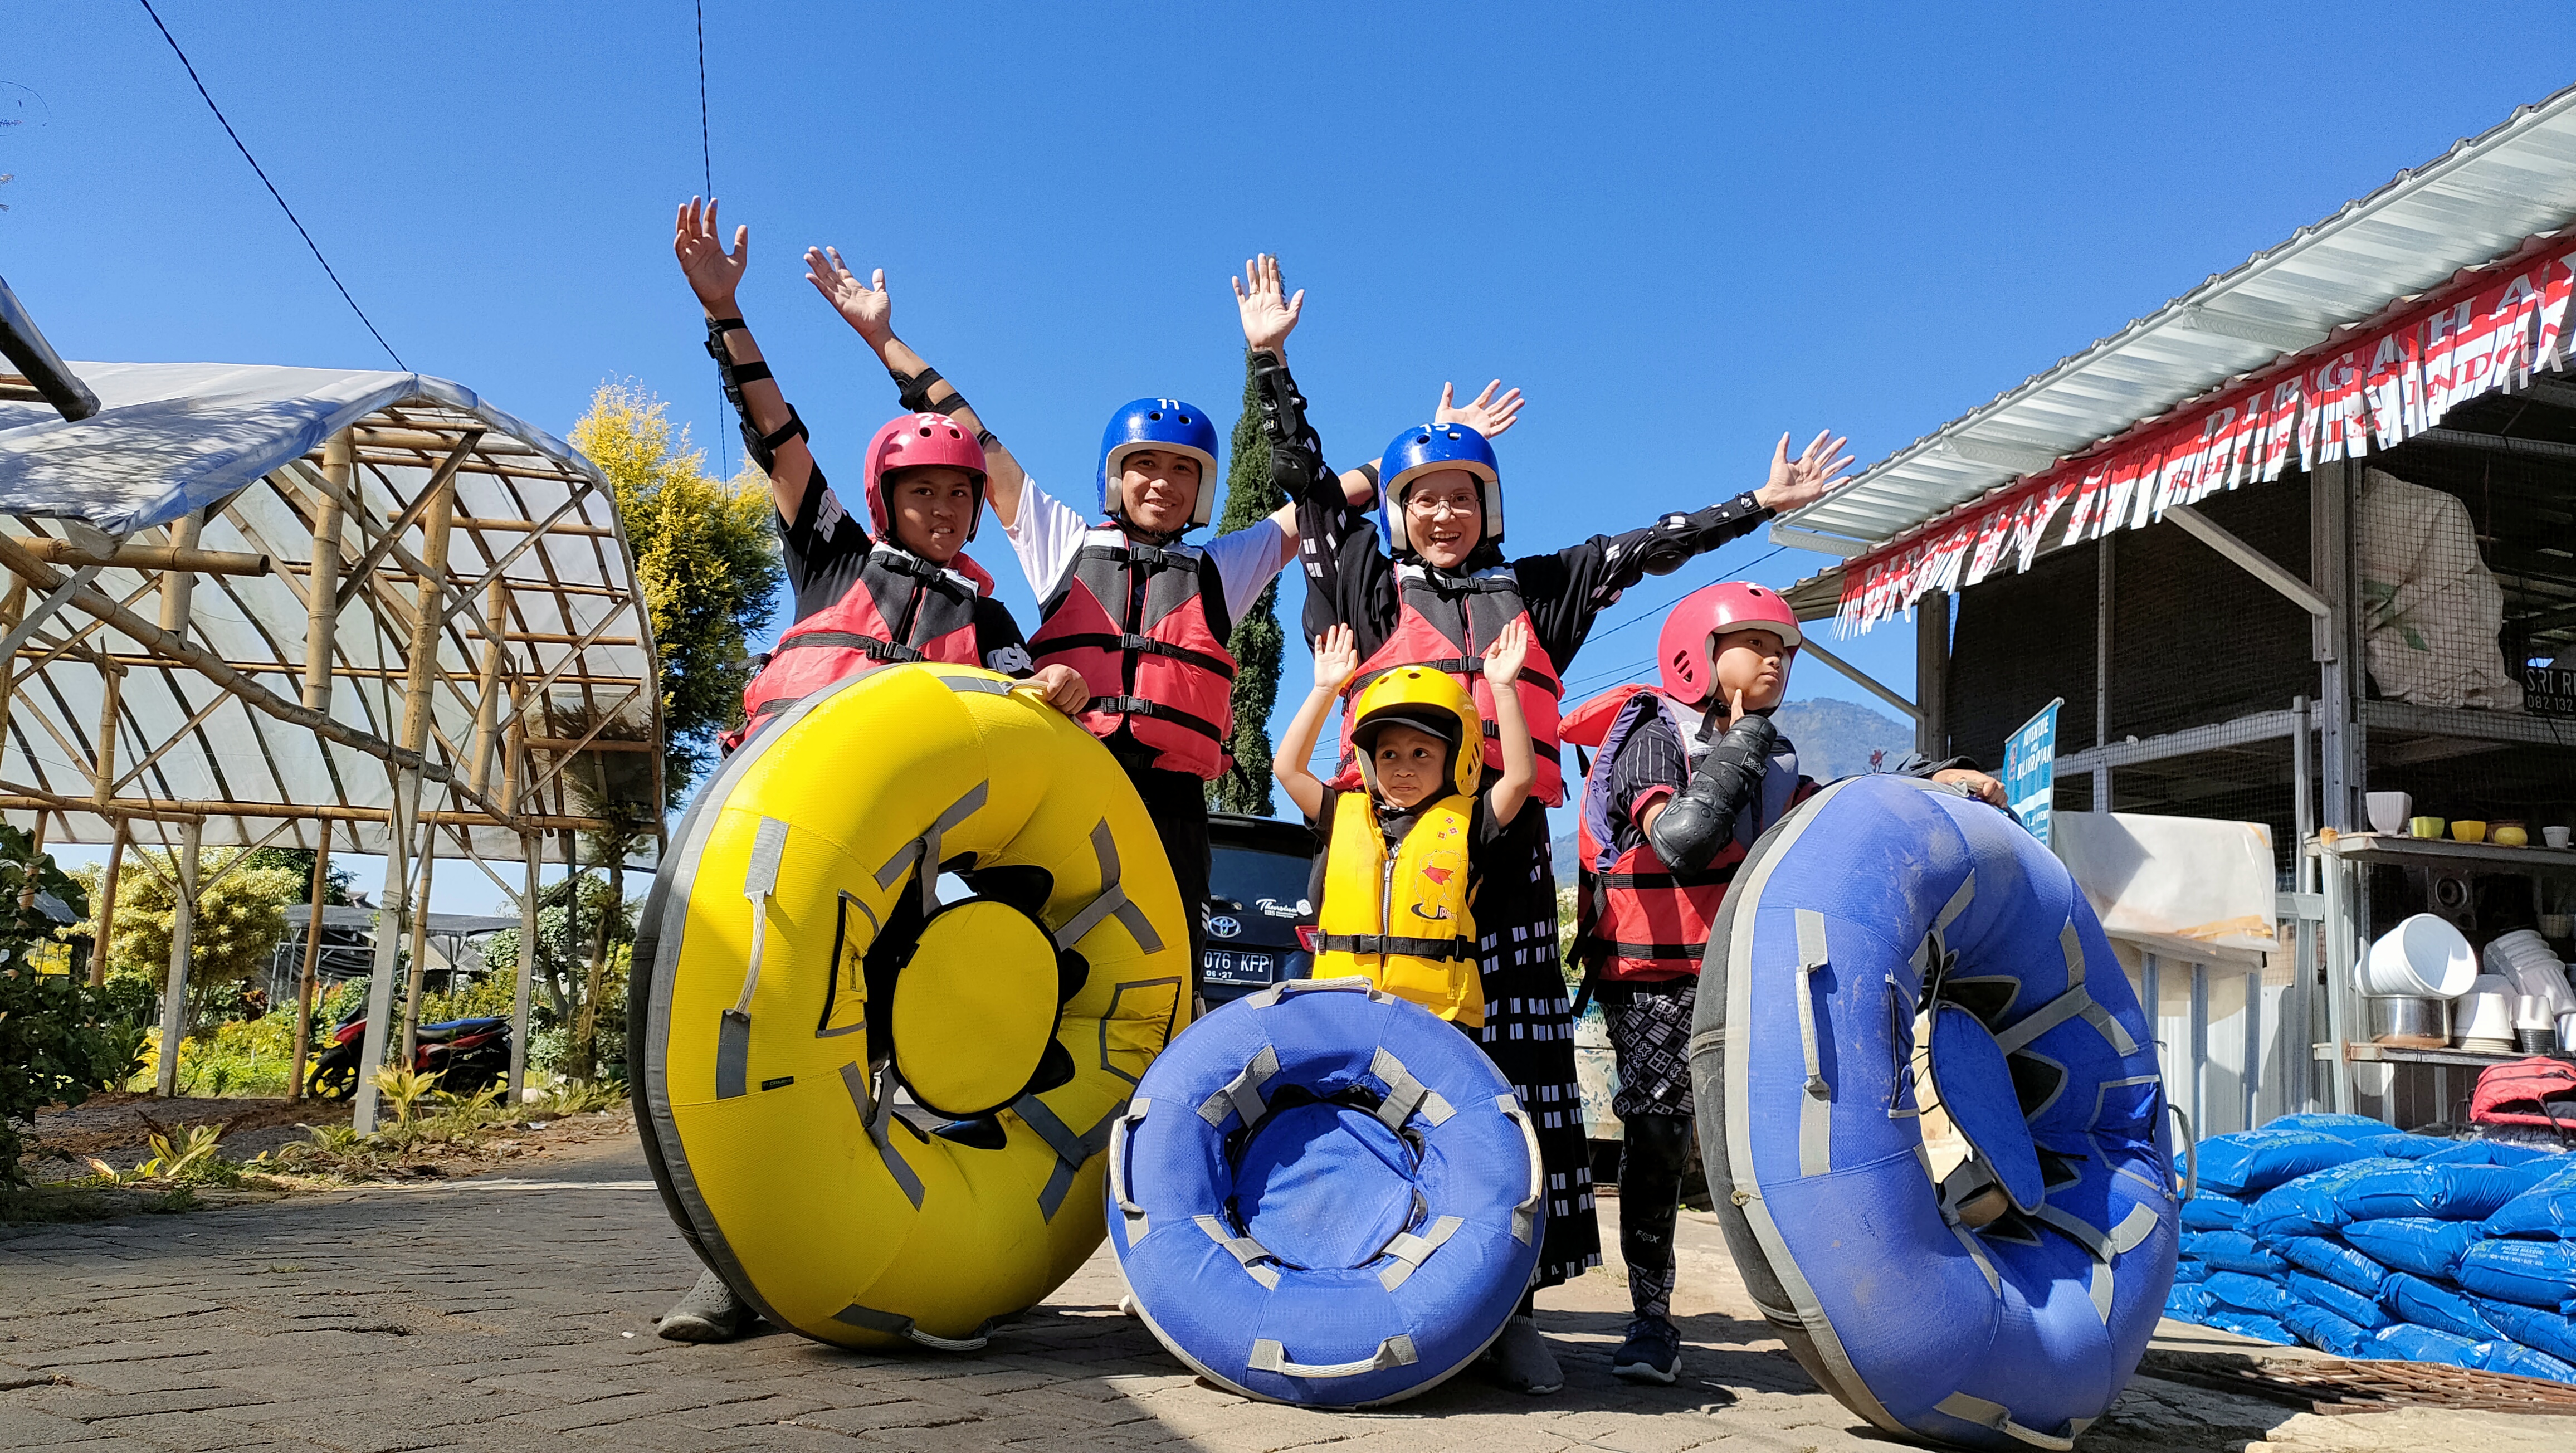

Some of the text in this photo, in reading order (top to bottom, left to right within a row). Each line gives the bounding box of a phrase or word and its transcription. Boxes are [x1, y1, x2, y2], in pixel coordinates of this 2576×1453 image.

[915, 413, 957, 428] 22
[2526, 669, 2554, 694] SRI
[2528, 695, 2573, 713] 082 132
[1204, 951, 1269, 973] 076 KFP
